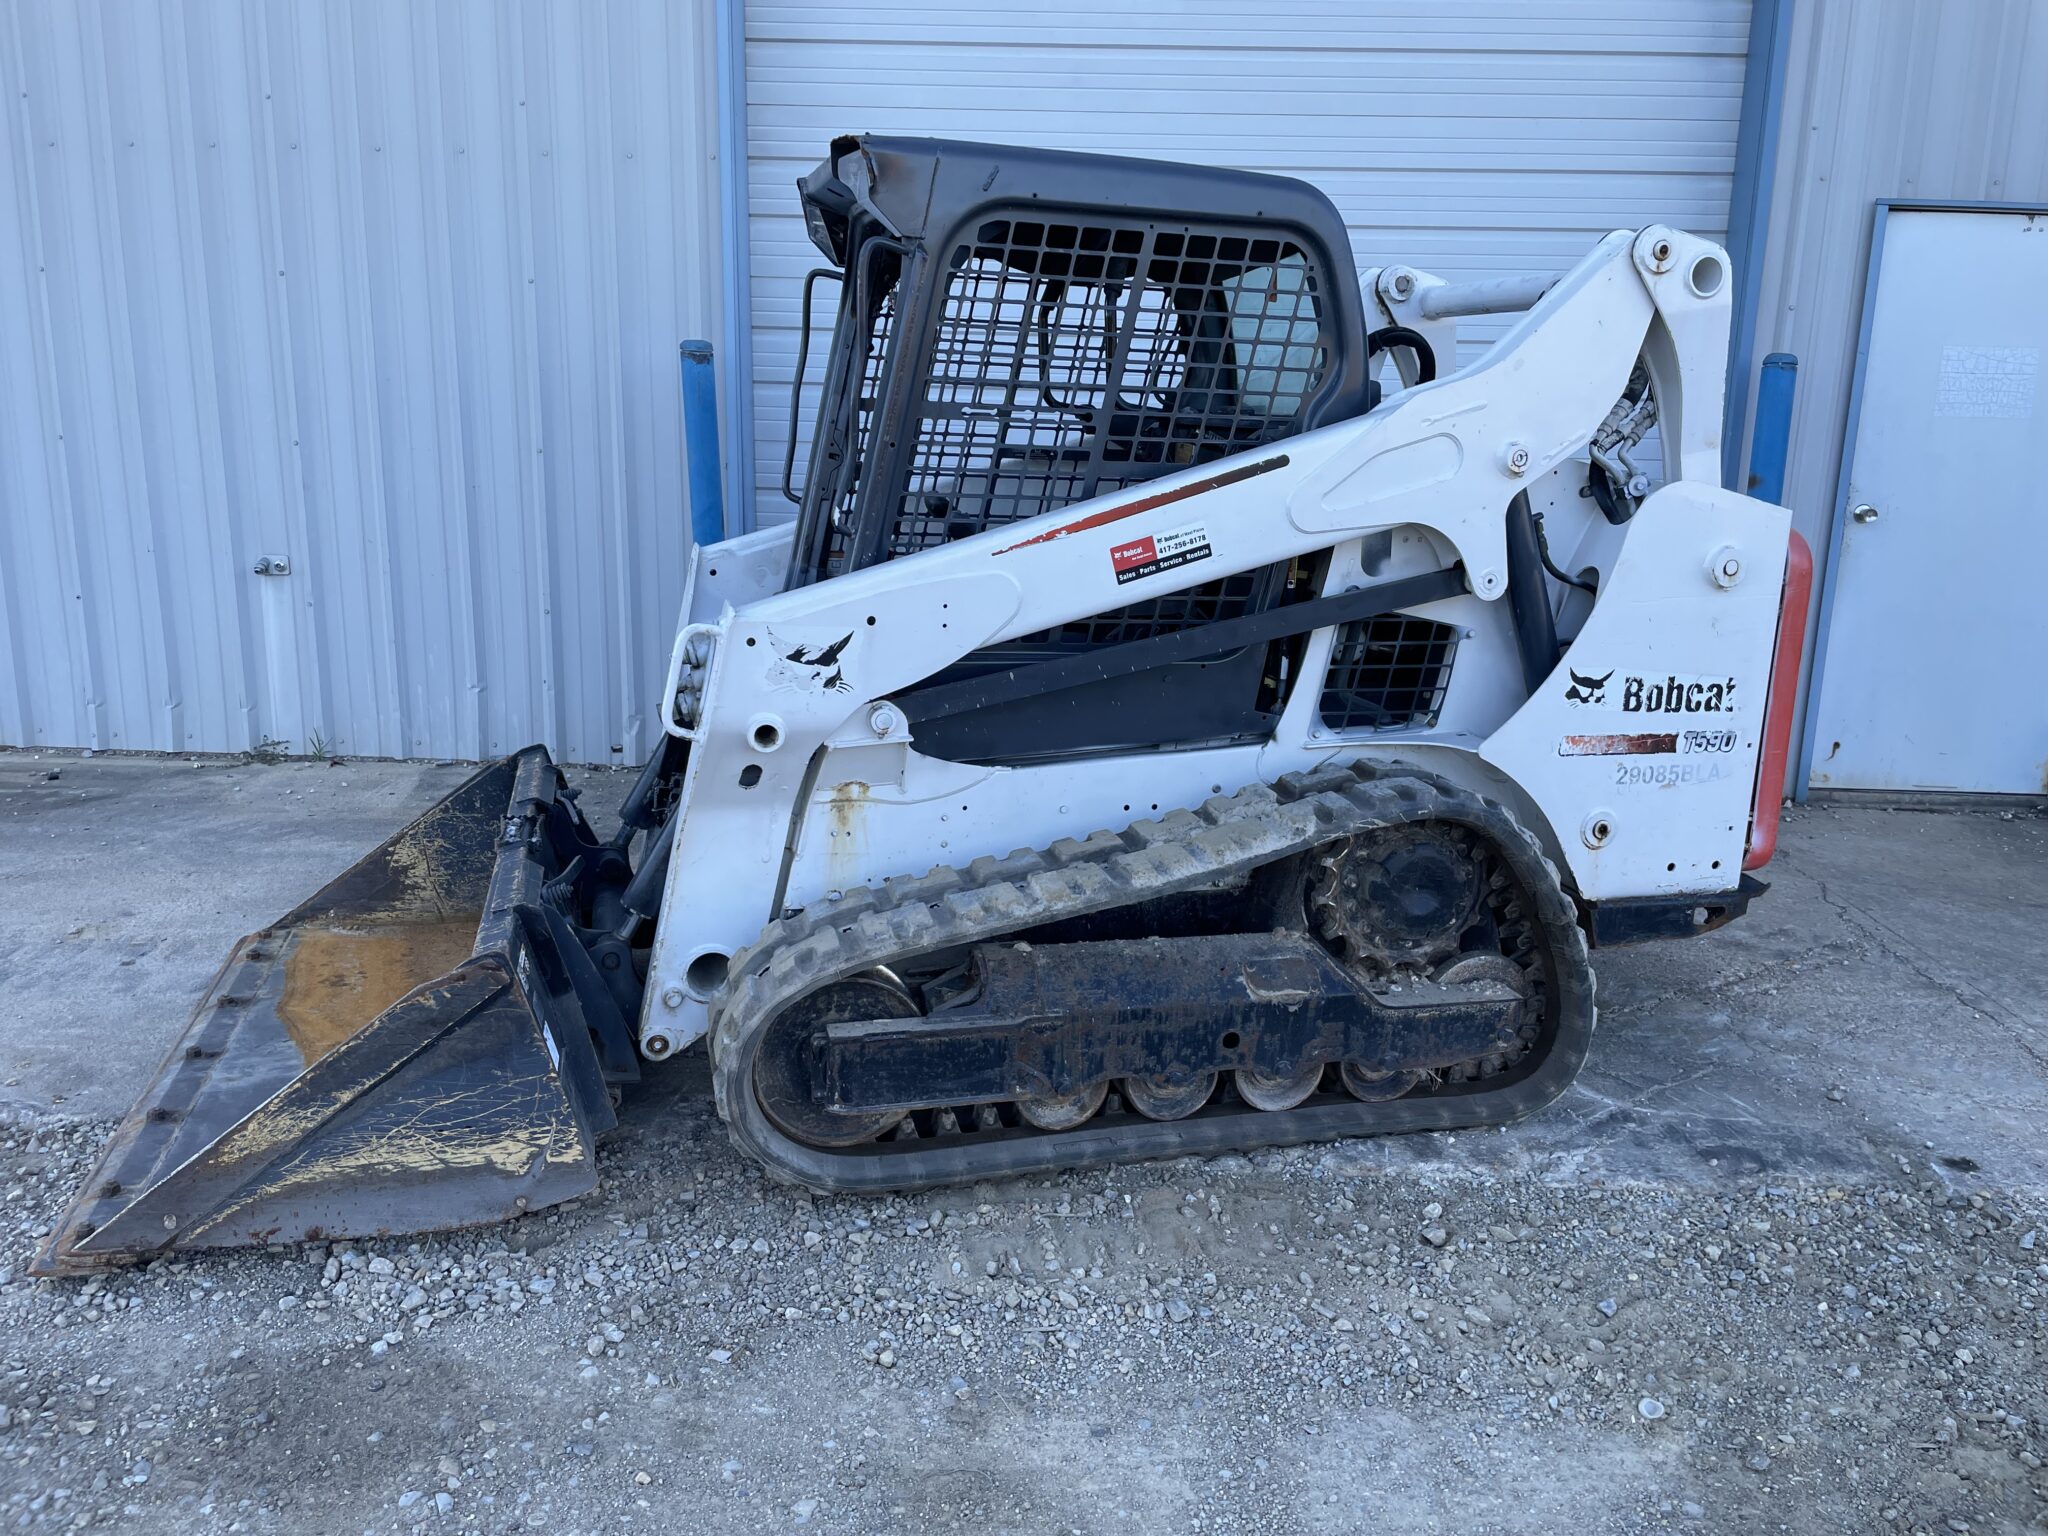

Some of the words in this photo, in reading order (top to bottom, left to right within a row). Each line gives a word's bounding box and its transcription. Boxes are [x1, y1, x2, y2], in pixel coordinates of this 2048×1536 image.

[1159, 534, 1207, 554] 417-256-8178
[1164, 533, 1180, 542] Bobcat
[1122, 546, 1143, 558] Bobcat
[1119, 571, 1136, 581] Sales
[1140, 564, 1156, 575] Parts
[1159, 557, 1183, 568] Service
[1186, 548, 1209, 560] Rentals
[1622, 675, 1737, 713] Bobcat
[1683, 730, 1738, 755] T590
